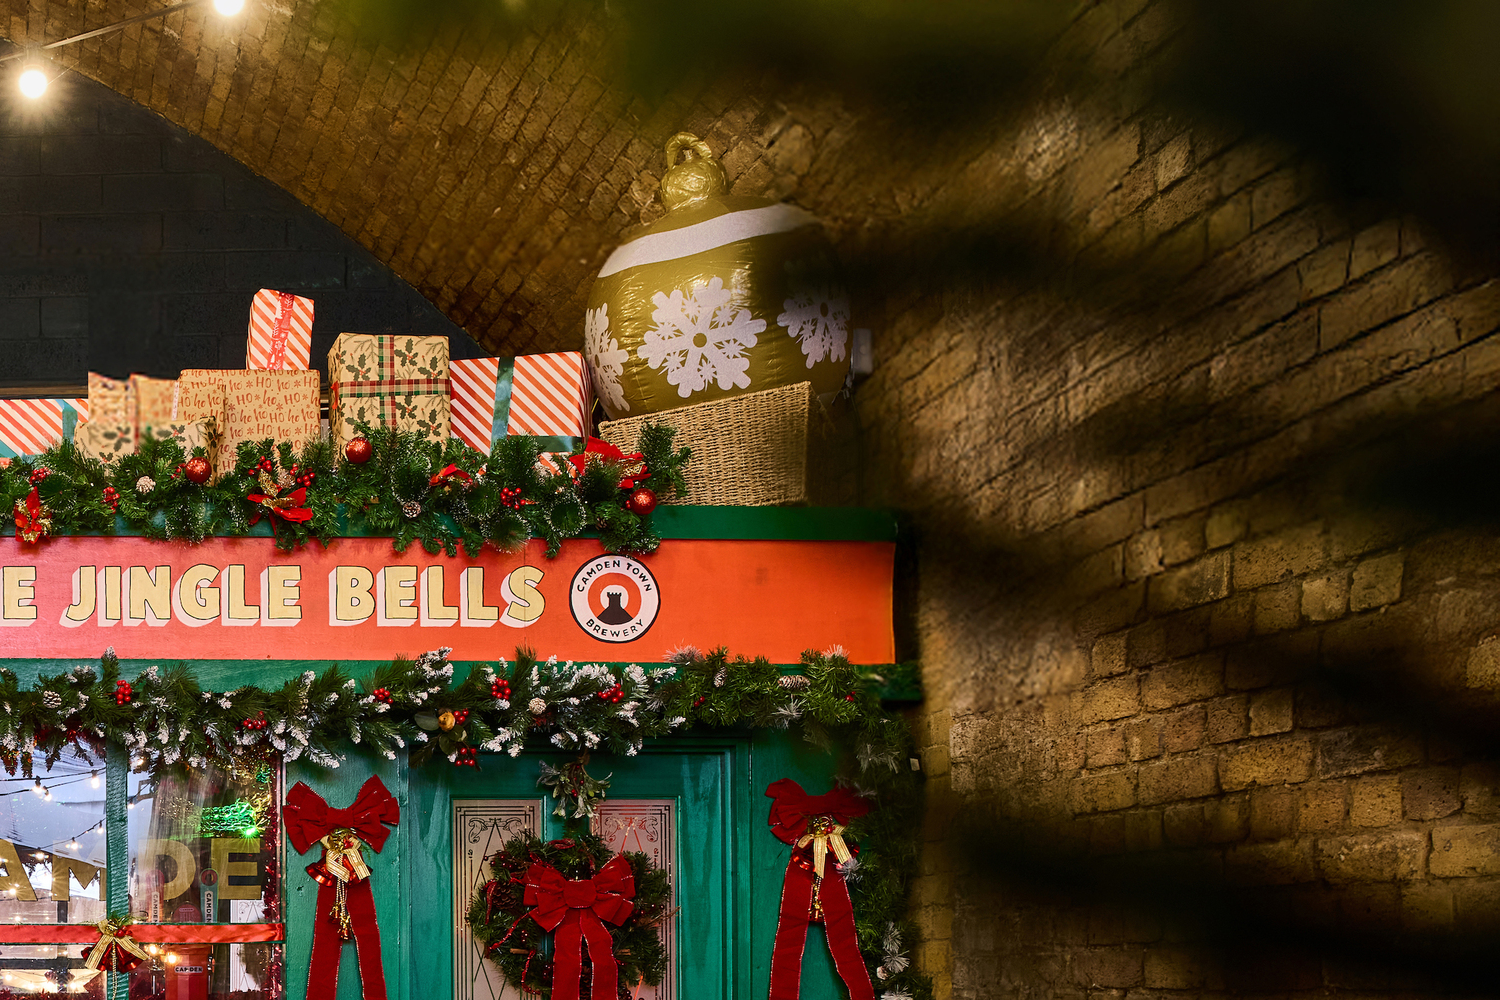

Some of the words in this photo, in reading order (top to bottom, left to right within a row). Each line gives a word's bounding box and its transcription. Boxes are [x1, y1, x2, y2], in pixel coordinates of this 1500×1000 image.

[576, 560, 620, 592] CAMDEN
[626, 562, 652, 592] TOWN
[58, 564, 302, 627] JINGLE
[328, 564, 546, 628] BELLS
[586, 618, 644, 638] BREWERY
